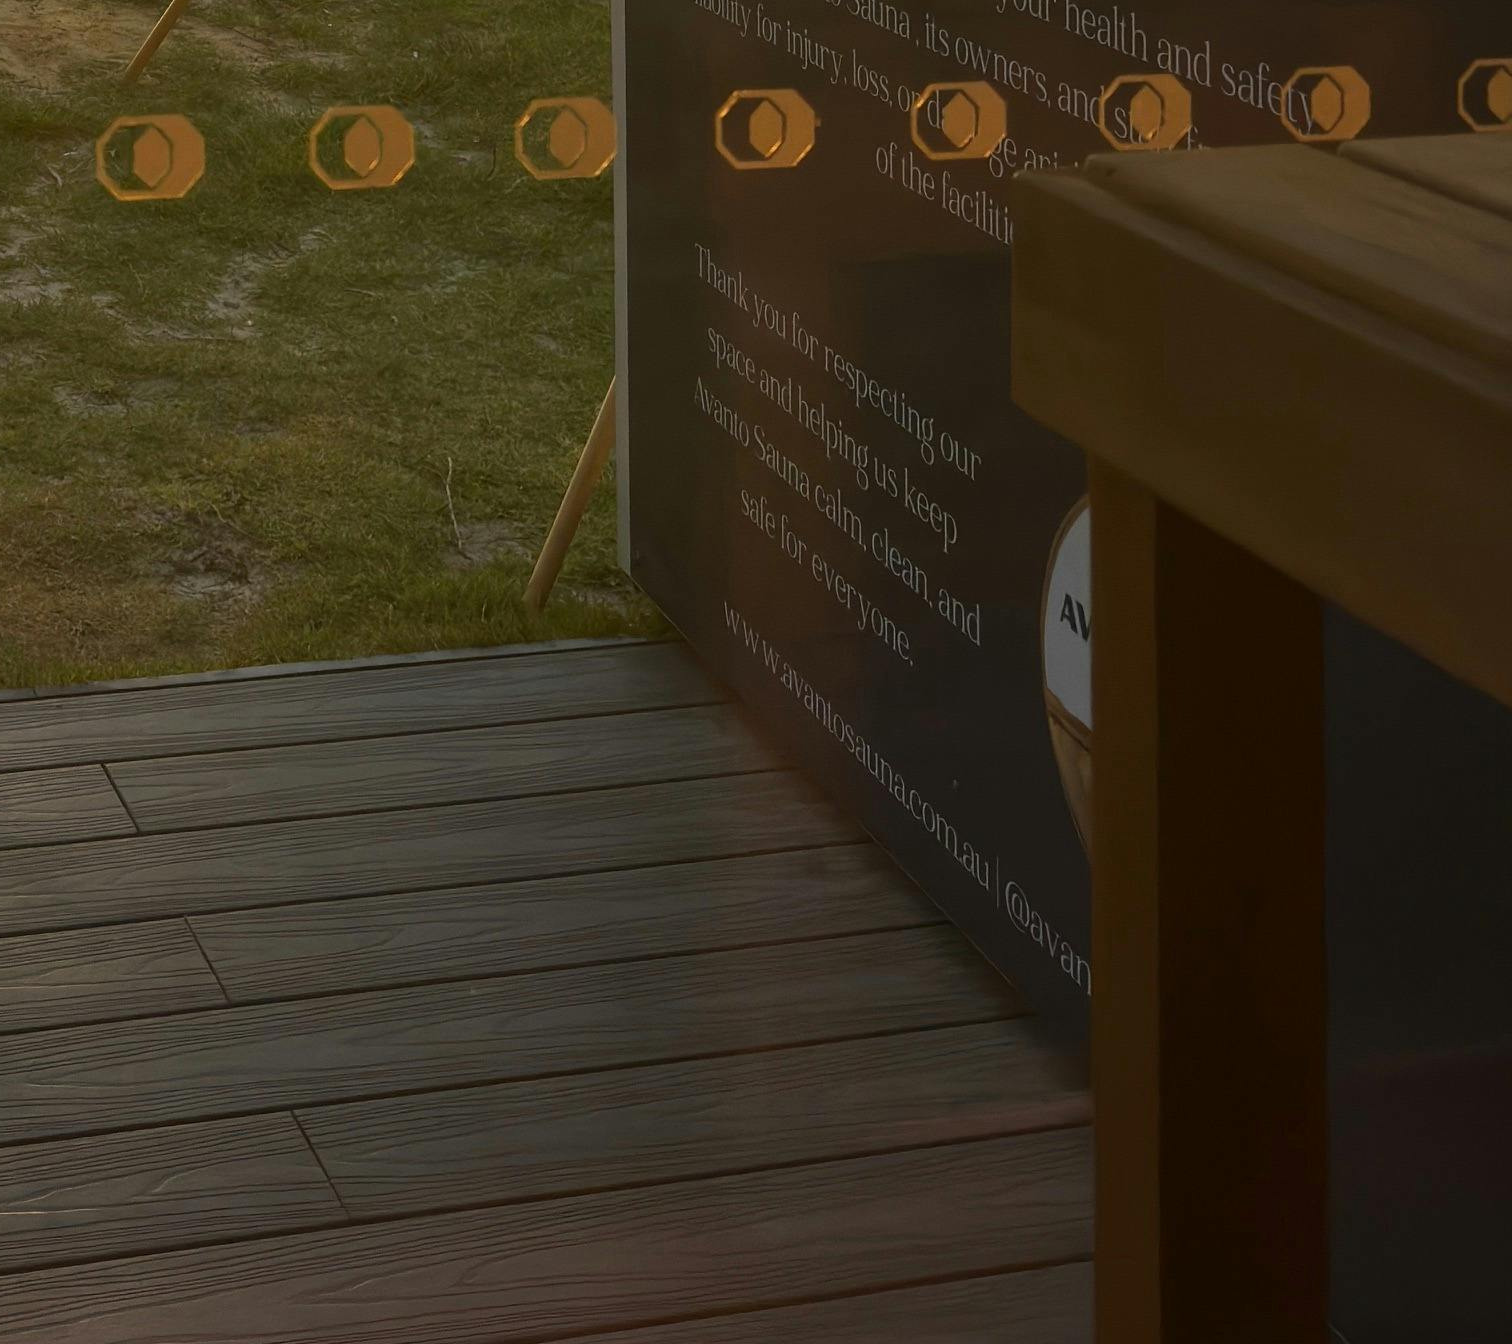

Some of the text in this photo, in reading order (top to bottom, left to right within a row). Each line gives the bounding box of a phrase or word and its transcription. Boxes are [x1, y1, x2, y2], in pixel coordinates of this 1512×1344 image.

[757, 3, 781, 45] for
[925, 13, 949, 56] its
[1057, 81, 1104, 128] and
[1157, 38, 1211, 87] and
[876, 142, 897, 179] of
[902, 151, 935, 200] the
[695, 243, 981, 481] Thank you for respecting our
[695, 377, 749, 447] Avanto
[754, 425, 809, 501] Sauna
[938, 588, 980, 646] and
[708, 328, 957, 554] space and helping us keep
[741, 490, 913, 667] safe for everyone.
[1060, 593, 1091, 642] AV
[724, 601, 989, 891] www.avantosauna.com.au
[1005, 881, 1091, 996] @avan
